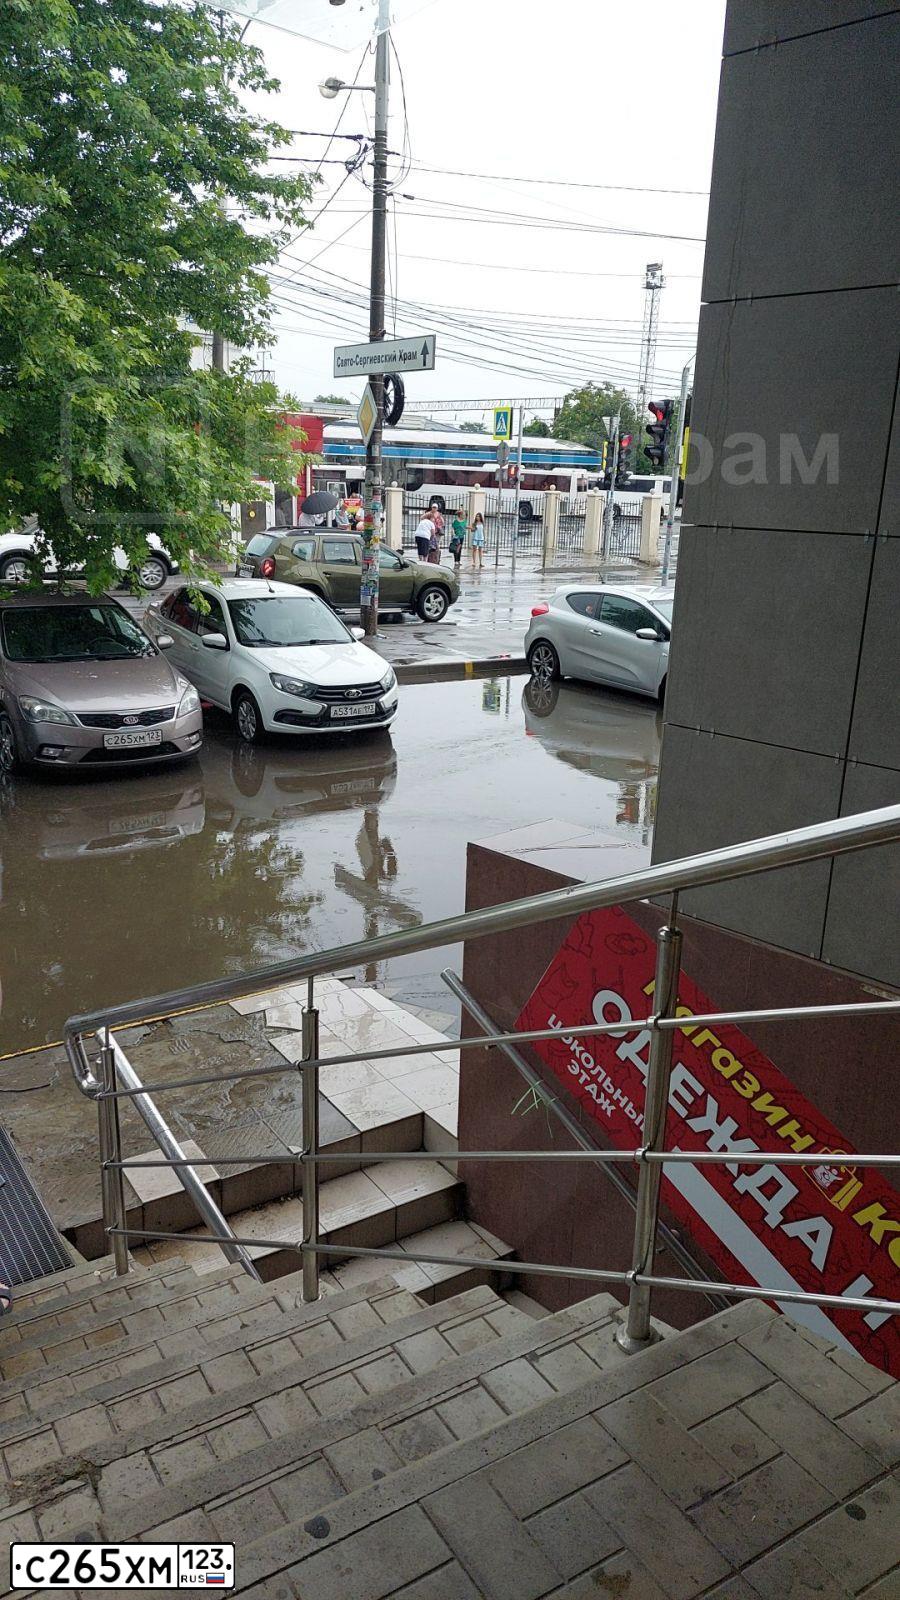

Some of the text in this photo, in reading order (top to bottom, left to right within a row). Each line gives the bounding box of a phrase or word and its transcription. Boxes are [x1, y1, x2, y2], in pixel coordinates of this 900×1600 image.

[336, 350, 417, 368] Свято-Сергиевский Храм
[147, 731, 161, 741] 123
[566, 1059, 616, 1118] ЭТАЖ
[643, 980, 816, 1153] агазин
[592, 989, 833, 1273] ОДЕЖДА
